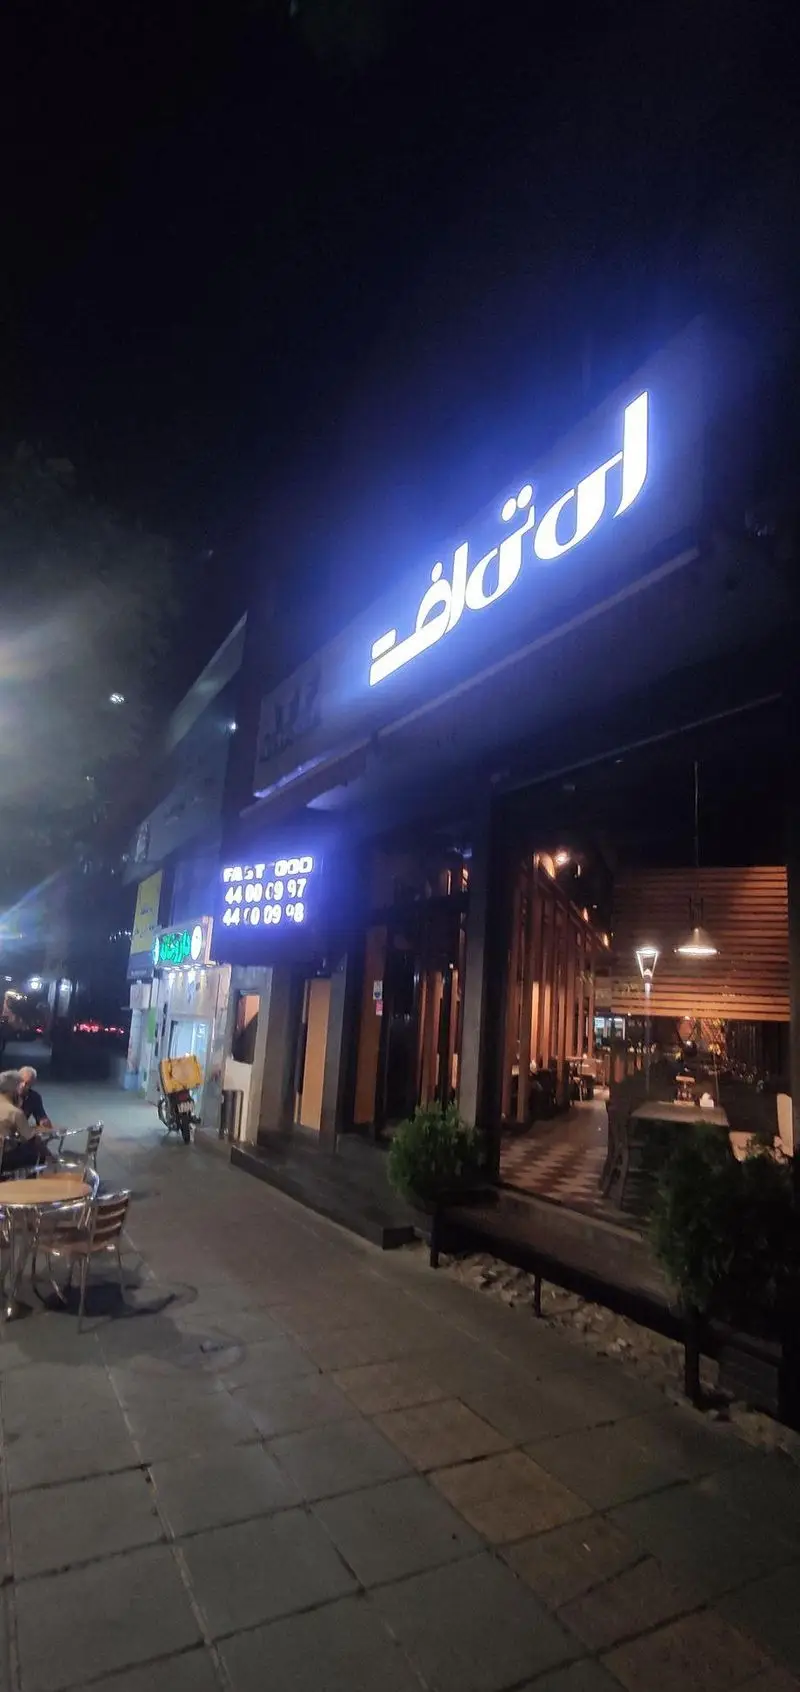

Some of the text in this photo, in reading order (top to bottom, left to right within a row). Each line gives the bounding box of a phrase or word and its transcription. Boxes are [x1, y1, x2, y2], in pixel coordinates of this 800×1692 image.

[223, 856, 313, 882] FAST OOD
[224, 885, 242, 905] 44
[287, 878, 307, 898] 97
[222, 907, 240, 927] 44
[263, 904, 282, 924] 09
